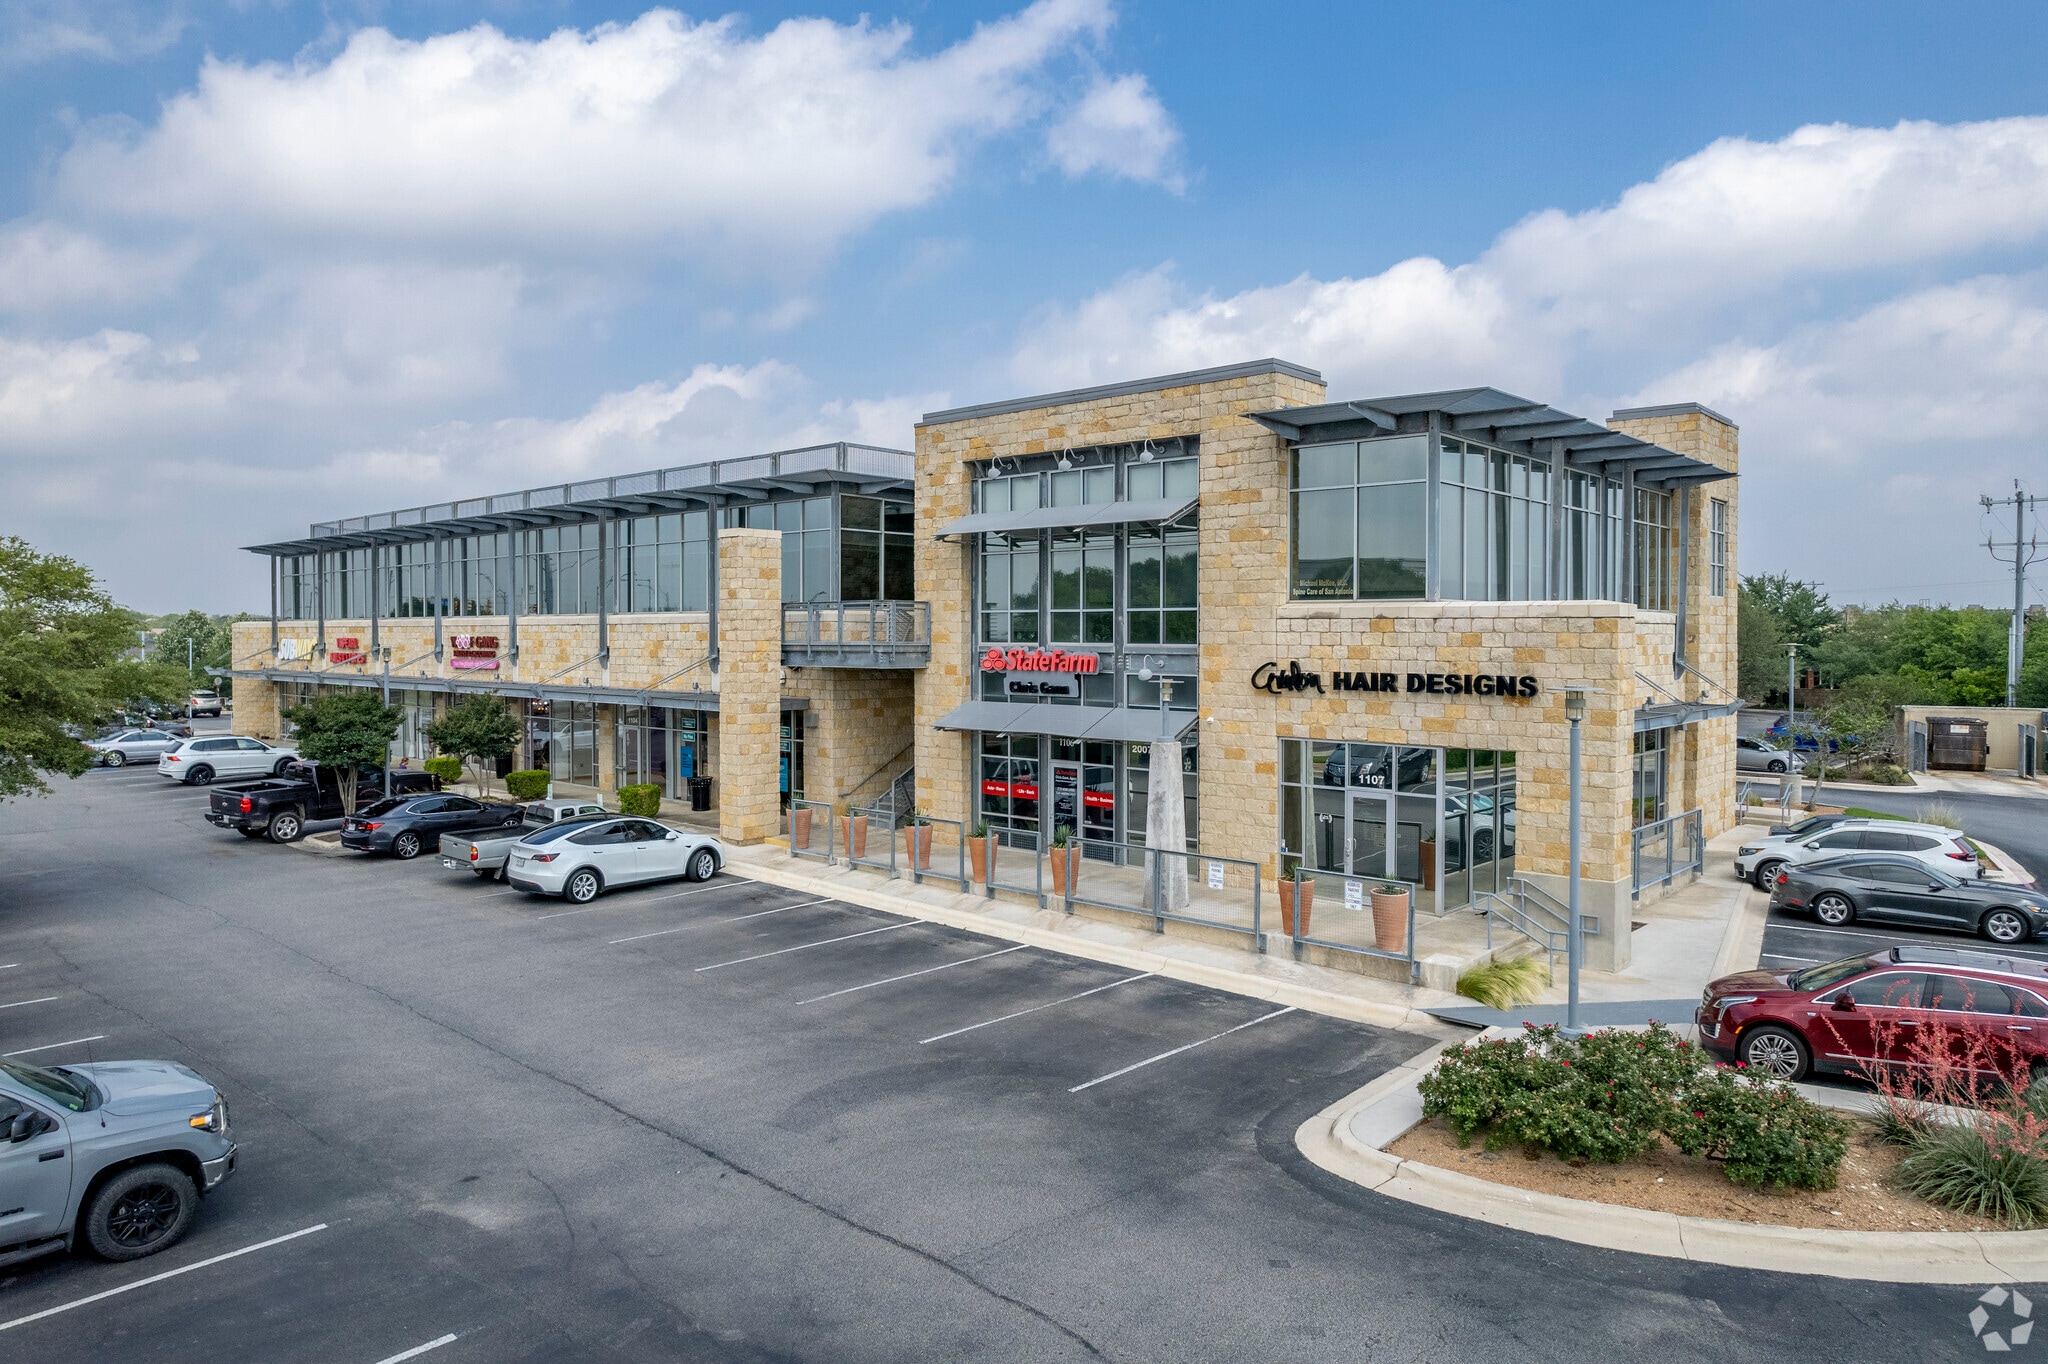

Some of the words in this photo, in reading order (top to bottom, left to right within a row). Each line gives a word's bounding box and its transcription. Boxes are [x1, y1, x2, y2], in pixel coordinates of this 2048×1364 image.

[1292, 588, 1306, 596] Spine
[278, 636, 319, 660] SUBWAY
[1333, 672, 1399, 693] HAIR
[1406, 673, 1538, 698] DESIGNS
[1358, 774, 1385, 785] 1107
